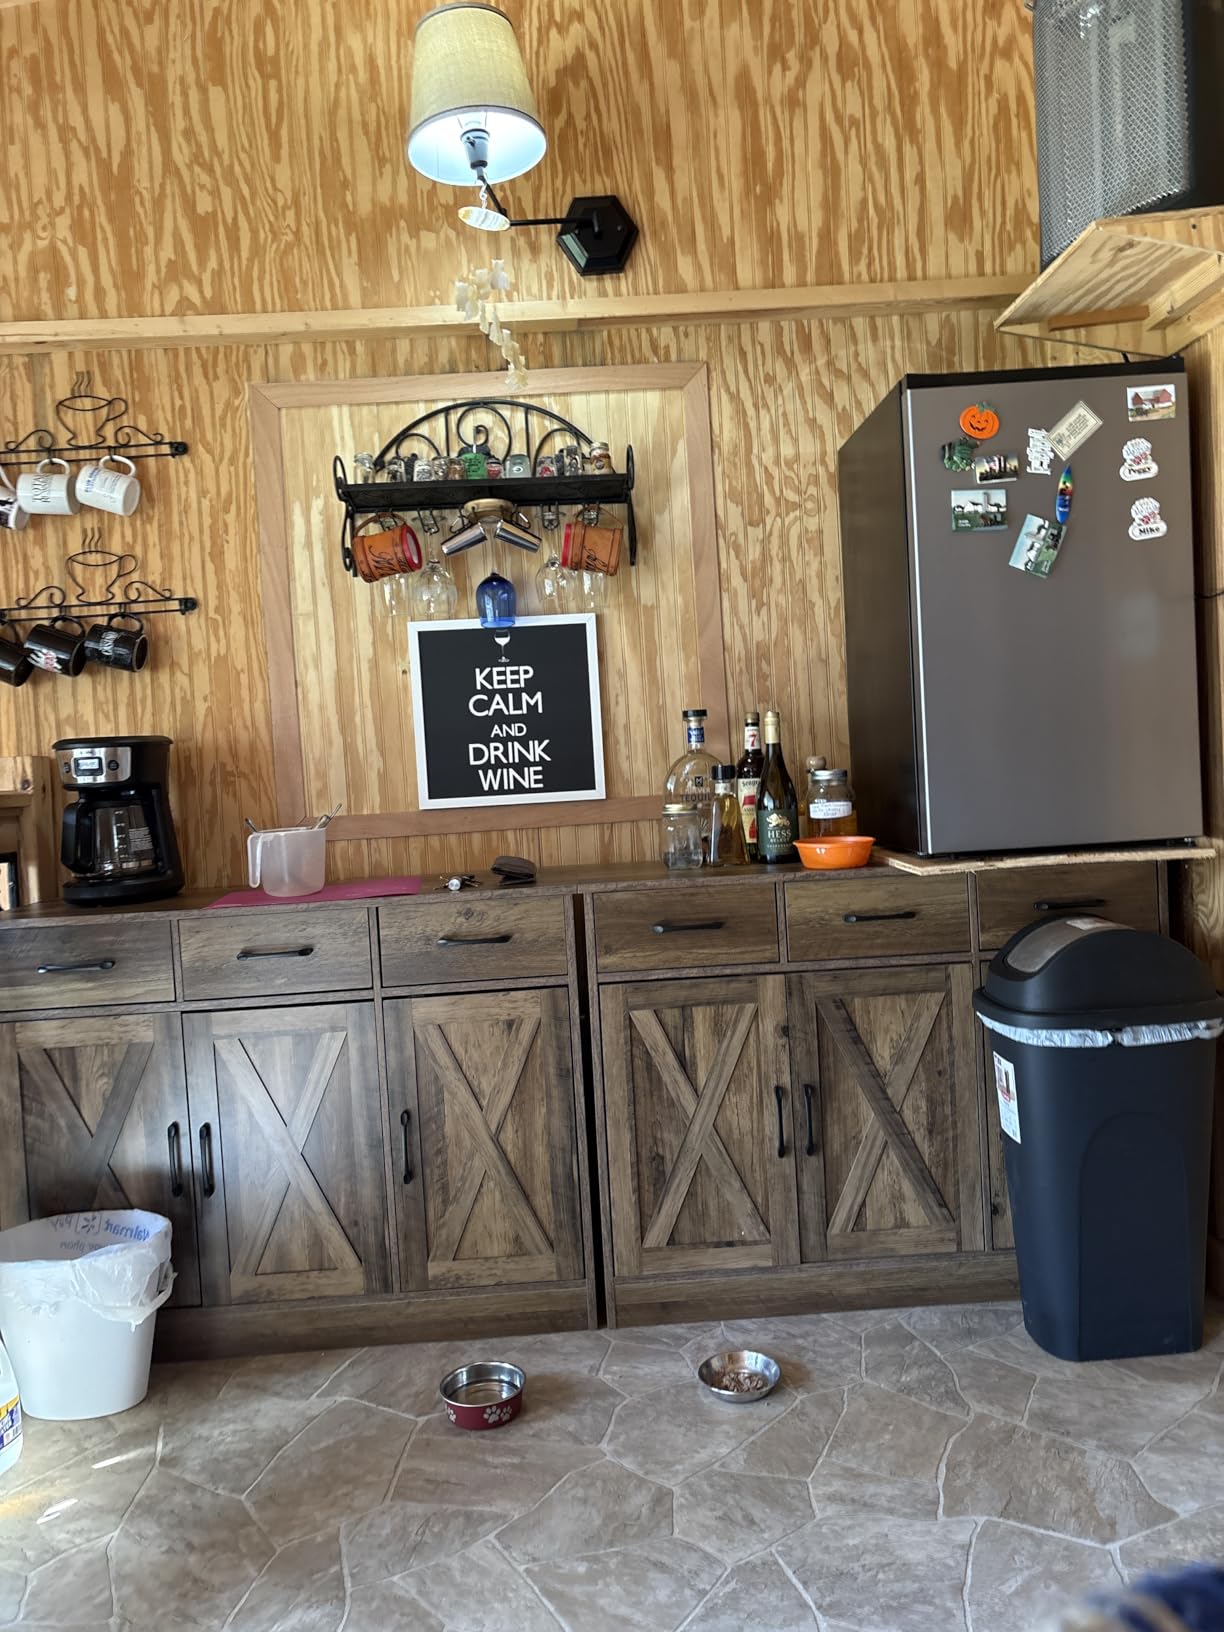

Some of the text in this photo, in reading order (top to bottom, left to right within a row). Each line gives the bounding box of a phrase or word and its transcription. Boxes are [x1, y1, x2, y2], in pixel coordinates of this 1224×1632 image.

[1139, 524, 1160, 536] Mike
[475, 665, 534, 690] KEEP
[468, 691, 543, 717] CALM
[490, 723, 527, 738] AND
[749, 733, 757, 747] 7
[468, 739, 551, 765] DRINK
[478, 766, 544, 791] WINE
[680, 793, 712, 802] TEQUIL
[767, 829, 792, 839] HESS
